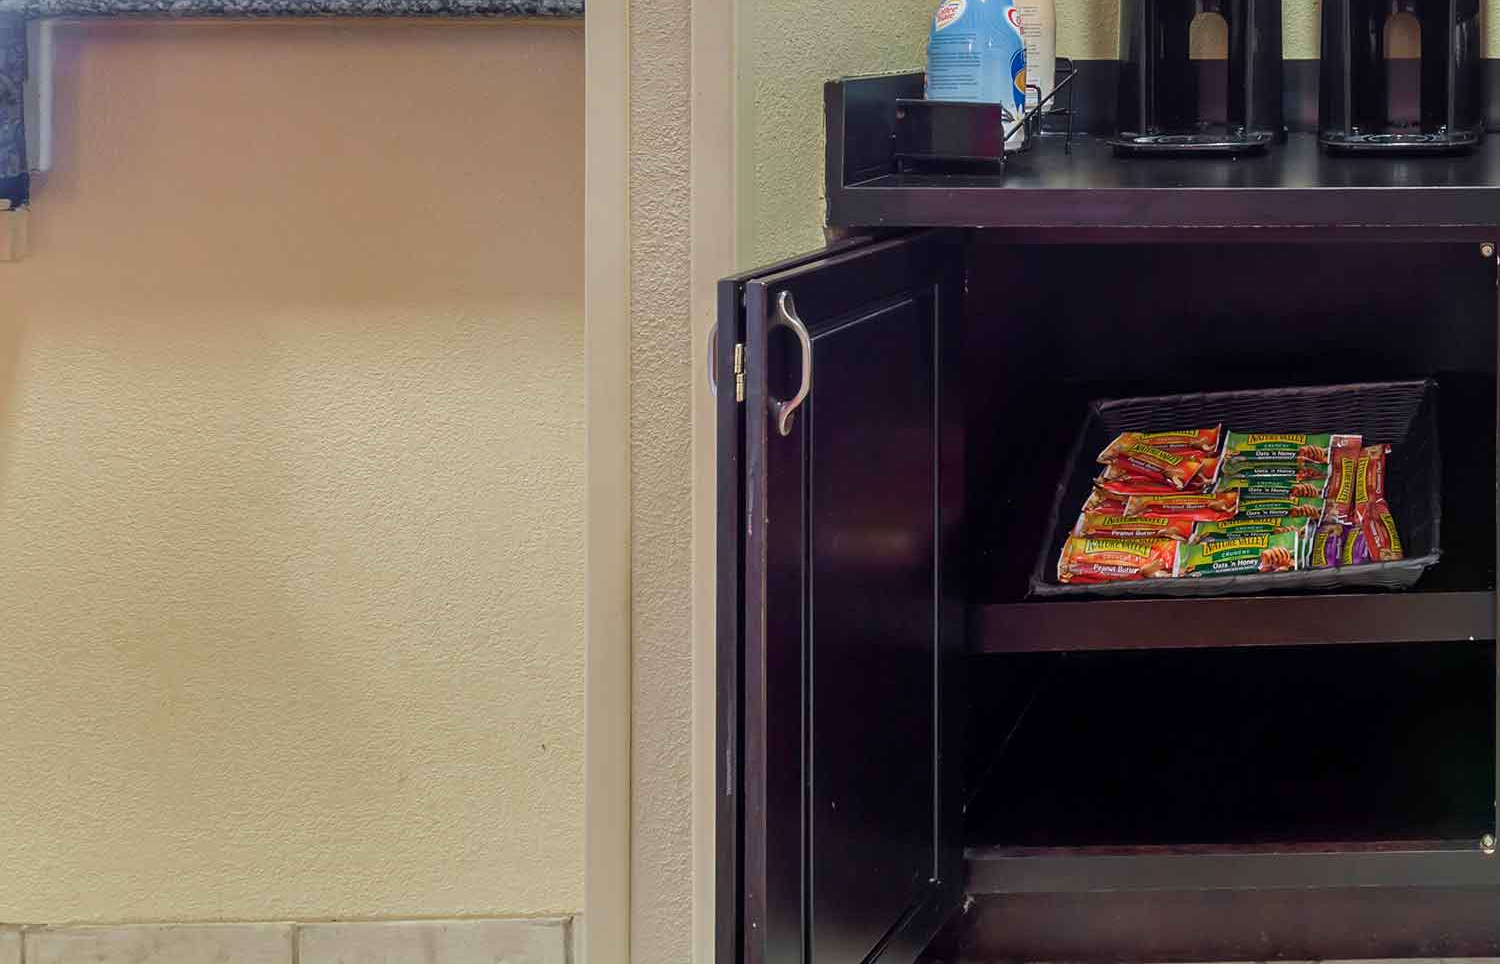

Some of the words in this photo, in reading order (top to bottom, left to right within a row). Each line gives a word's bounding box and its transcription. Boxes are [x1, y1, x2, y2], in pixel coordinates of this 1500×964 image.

[1277, 451, 1297, 460] Honey
[1111, 529, 1135, 537] Peanut
[1203, 539, 1238, 556] NATURE
[1238, 535, 1270, 549] VALLEY
[1237, 558, 1259, 567] Honey
[1093, 563, 1117, 574] Peanut
[1117, 565, 1140, 574] Butter
